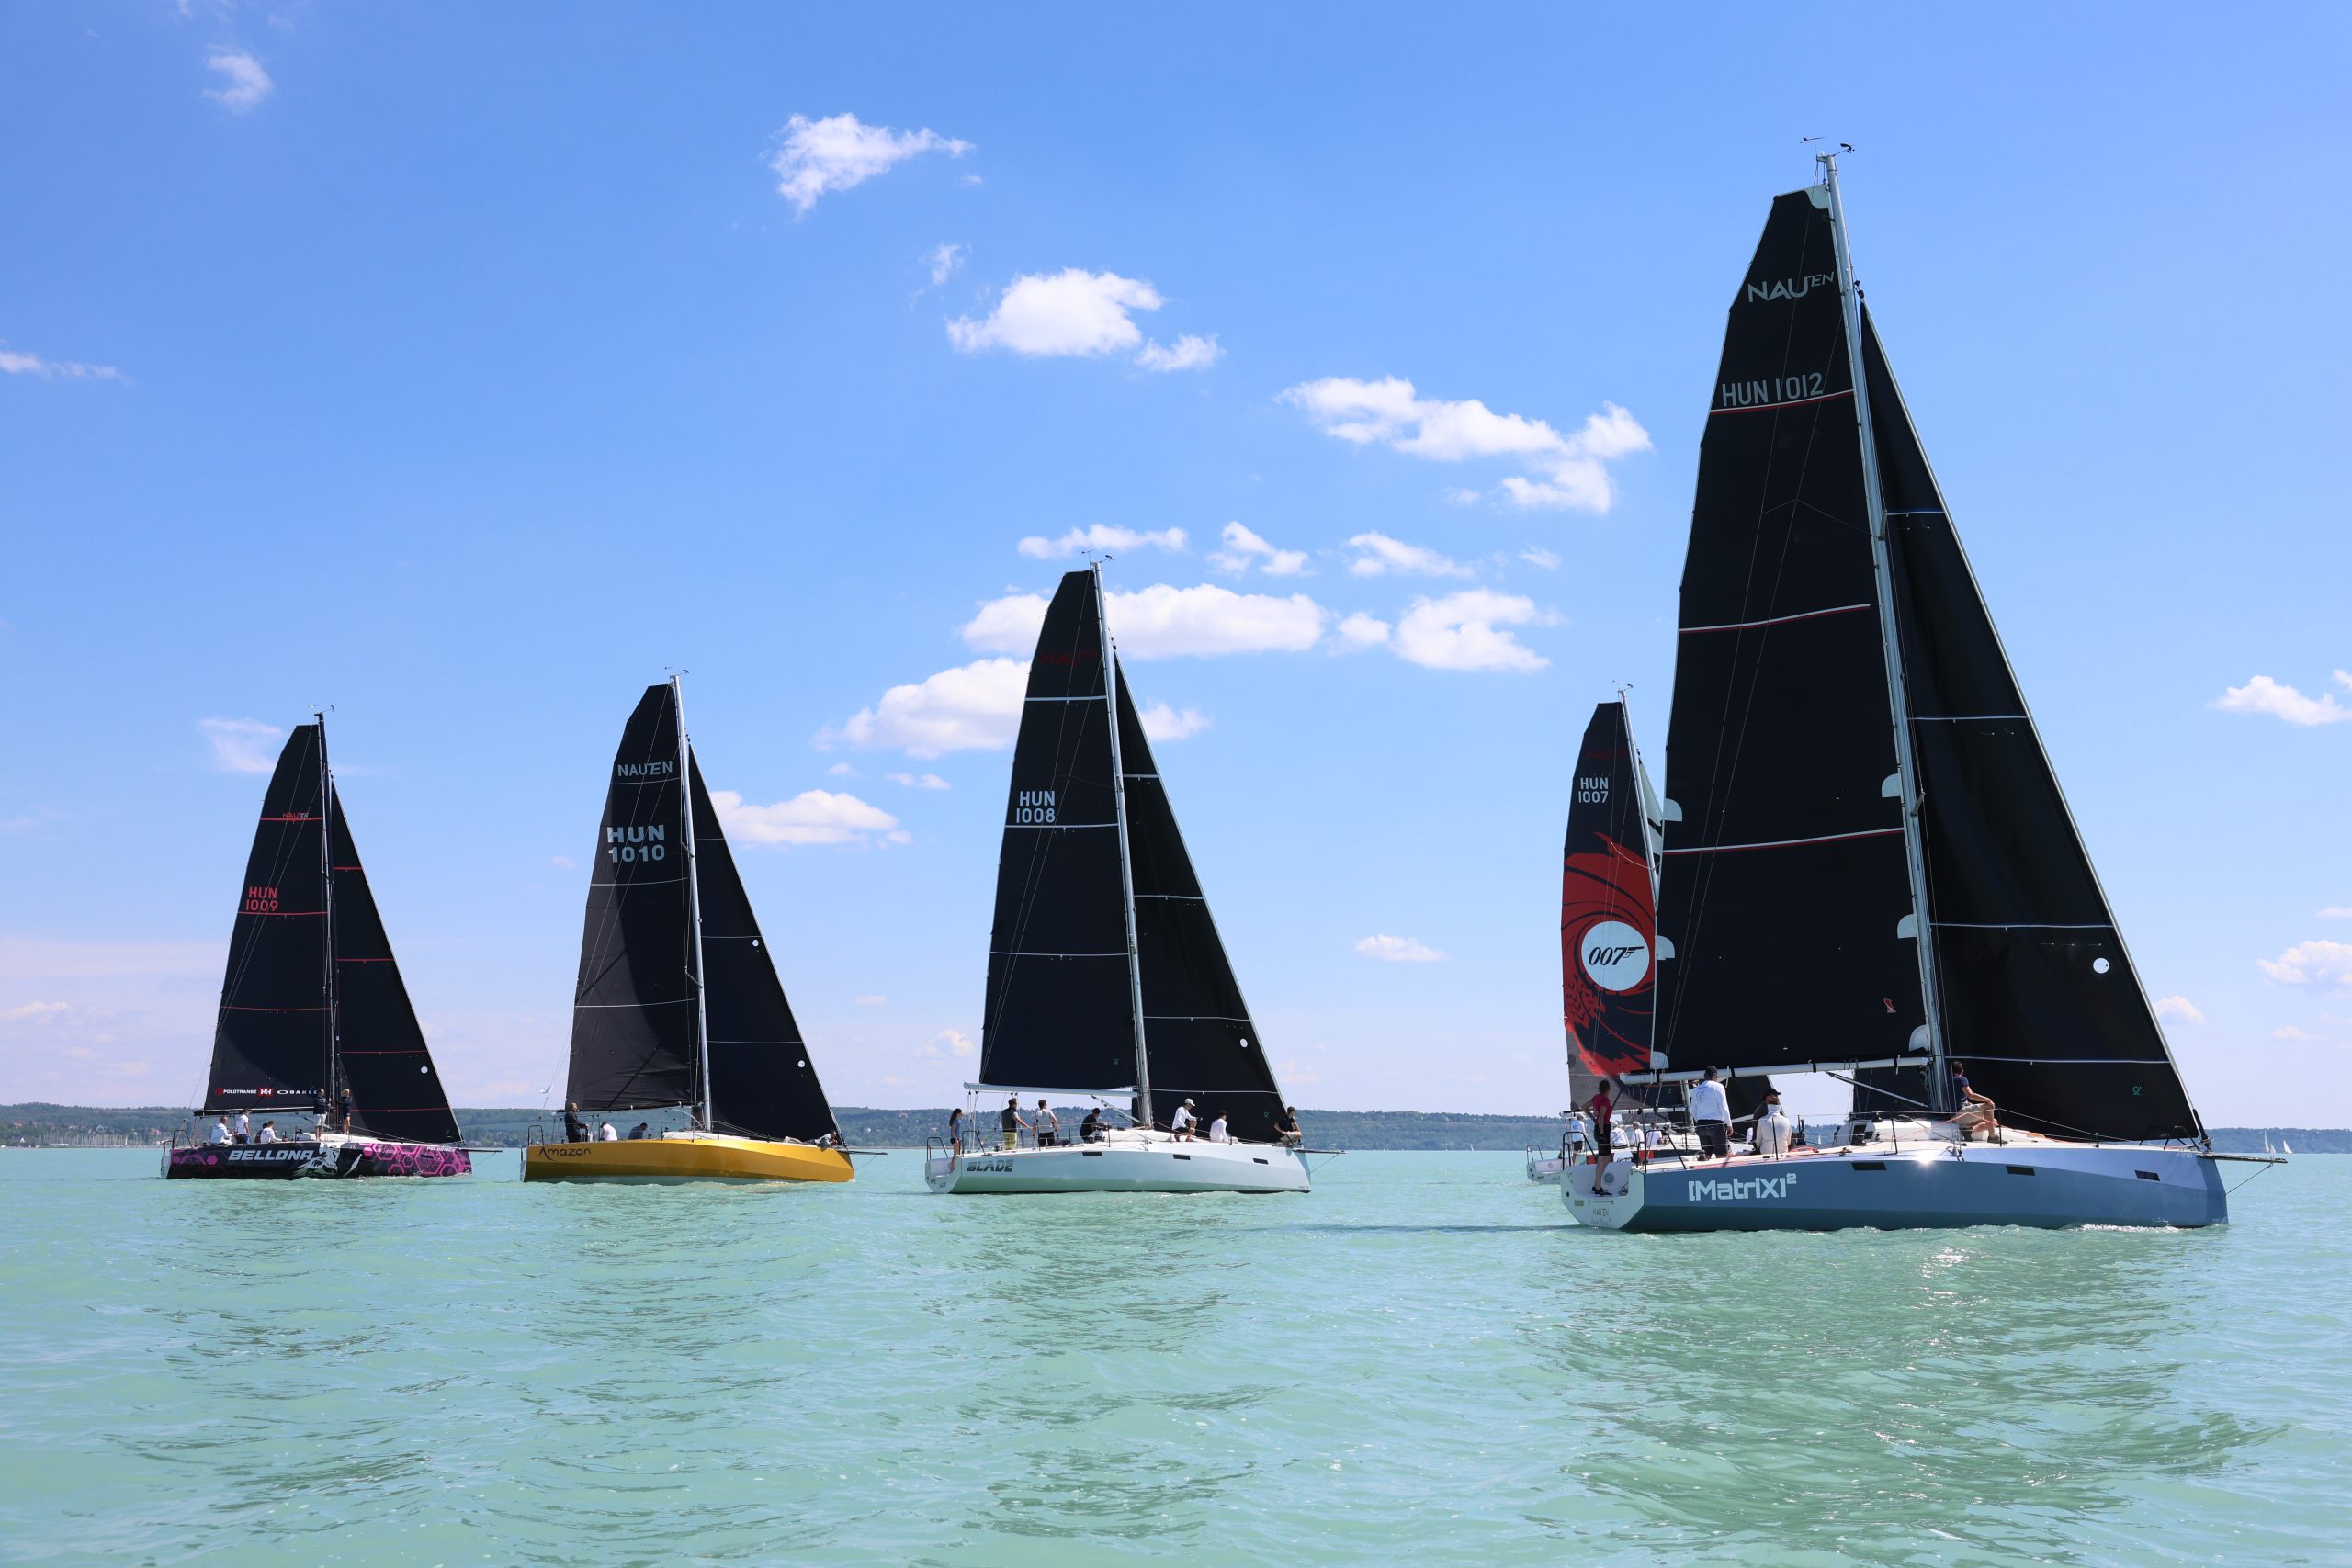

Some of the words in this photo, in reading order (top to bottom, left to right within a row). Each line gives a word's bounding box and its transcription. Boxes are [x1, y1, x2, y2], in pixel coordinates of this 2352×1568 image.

[1722, 379, 1769, 407] HUN
[1775, 372, 1823, 401] 1012
[1580, 777, 1609, 790] HUN
[1019, 791, 1055, 806] HUN
[1578, 791, 1609, 804] 1007
[1016, 807, 1056, 823] 1008
[606, 825, 665, 843] HUN
[608, 845, 665, 863] 1010
[248, 886, 277, 898] HUN
[245, 899, 278, 911] 1009
[1589, 947, 1630, 966] 007
[229, 1150, 314, 1161] BELLONA
[537, 1146, 592, 1162] Amazon
[967, 1159, 1014, 1172] BLADE
